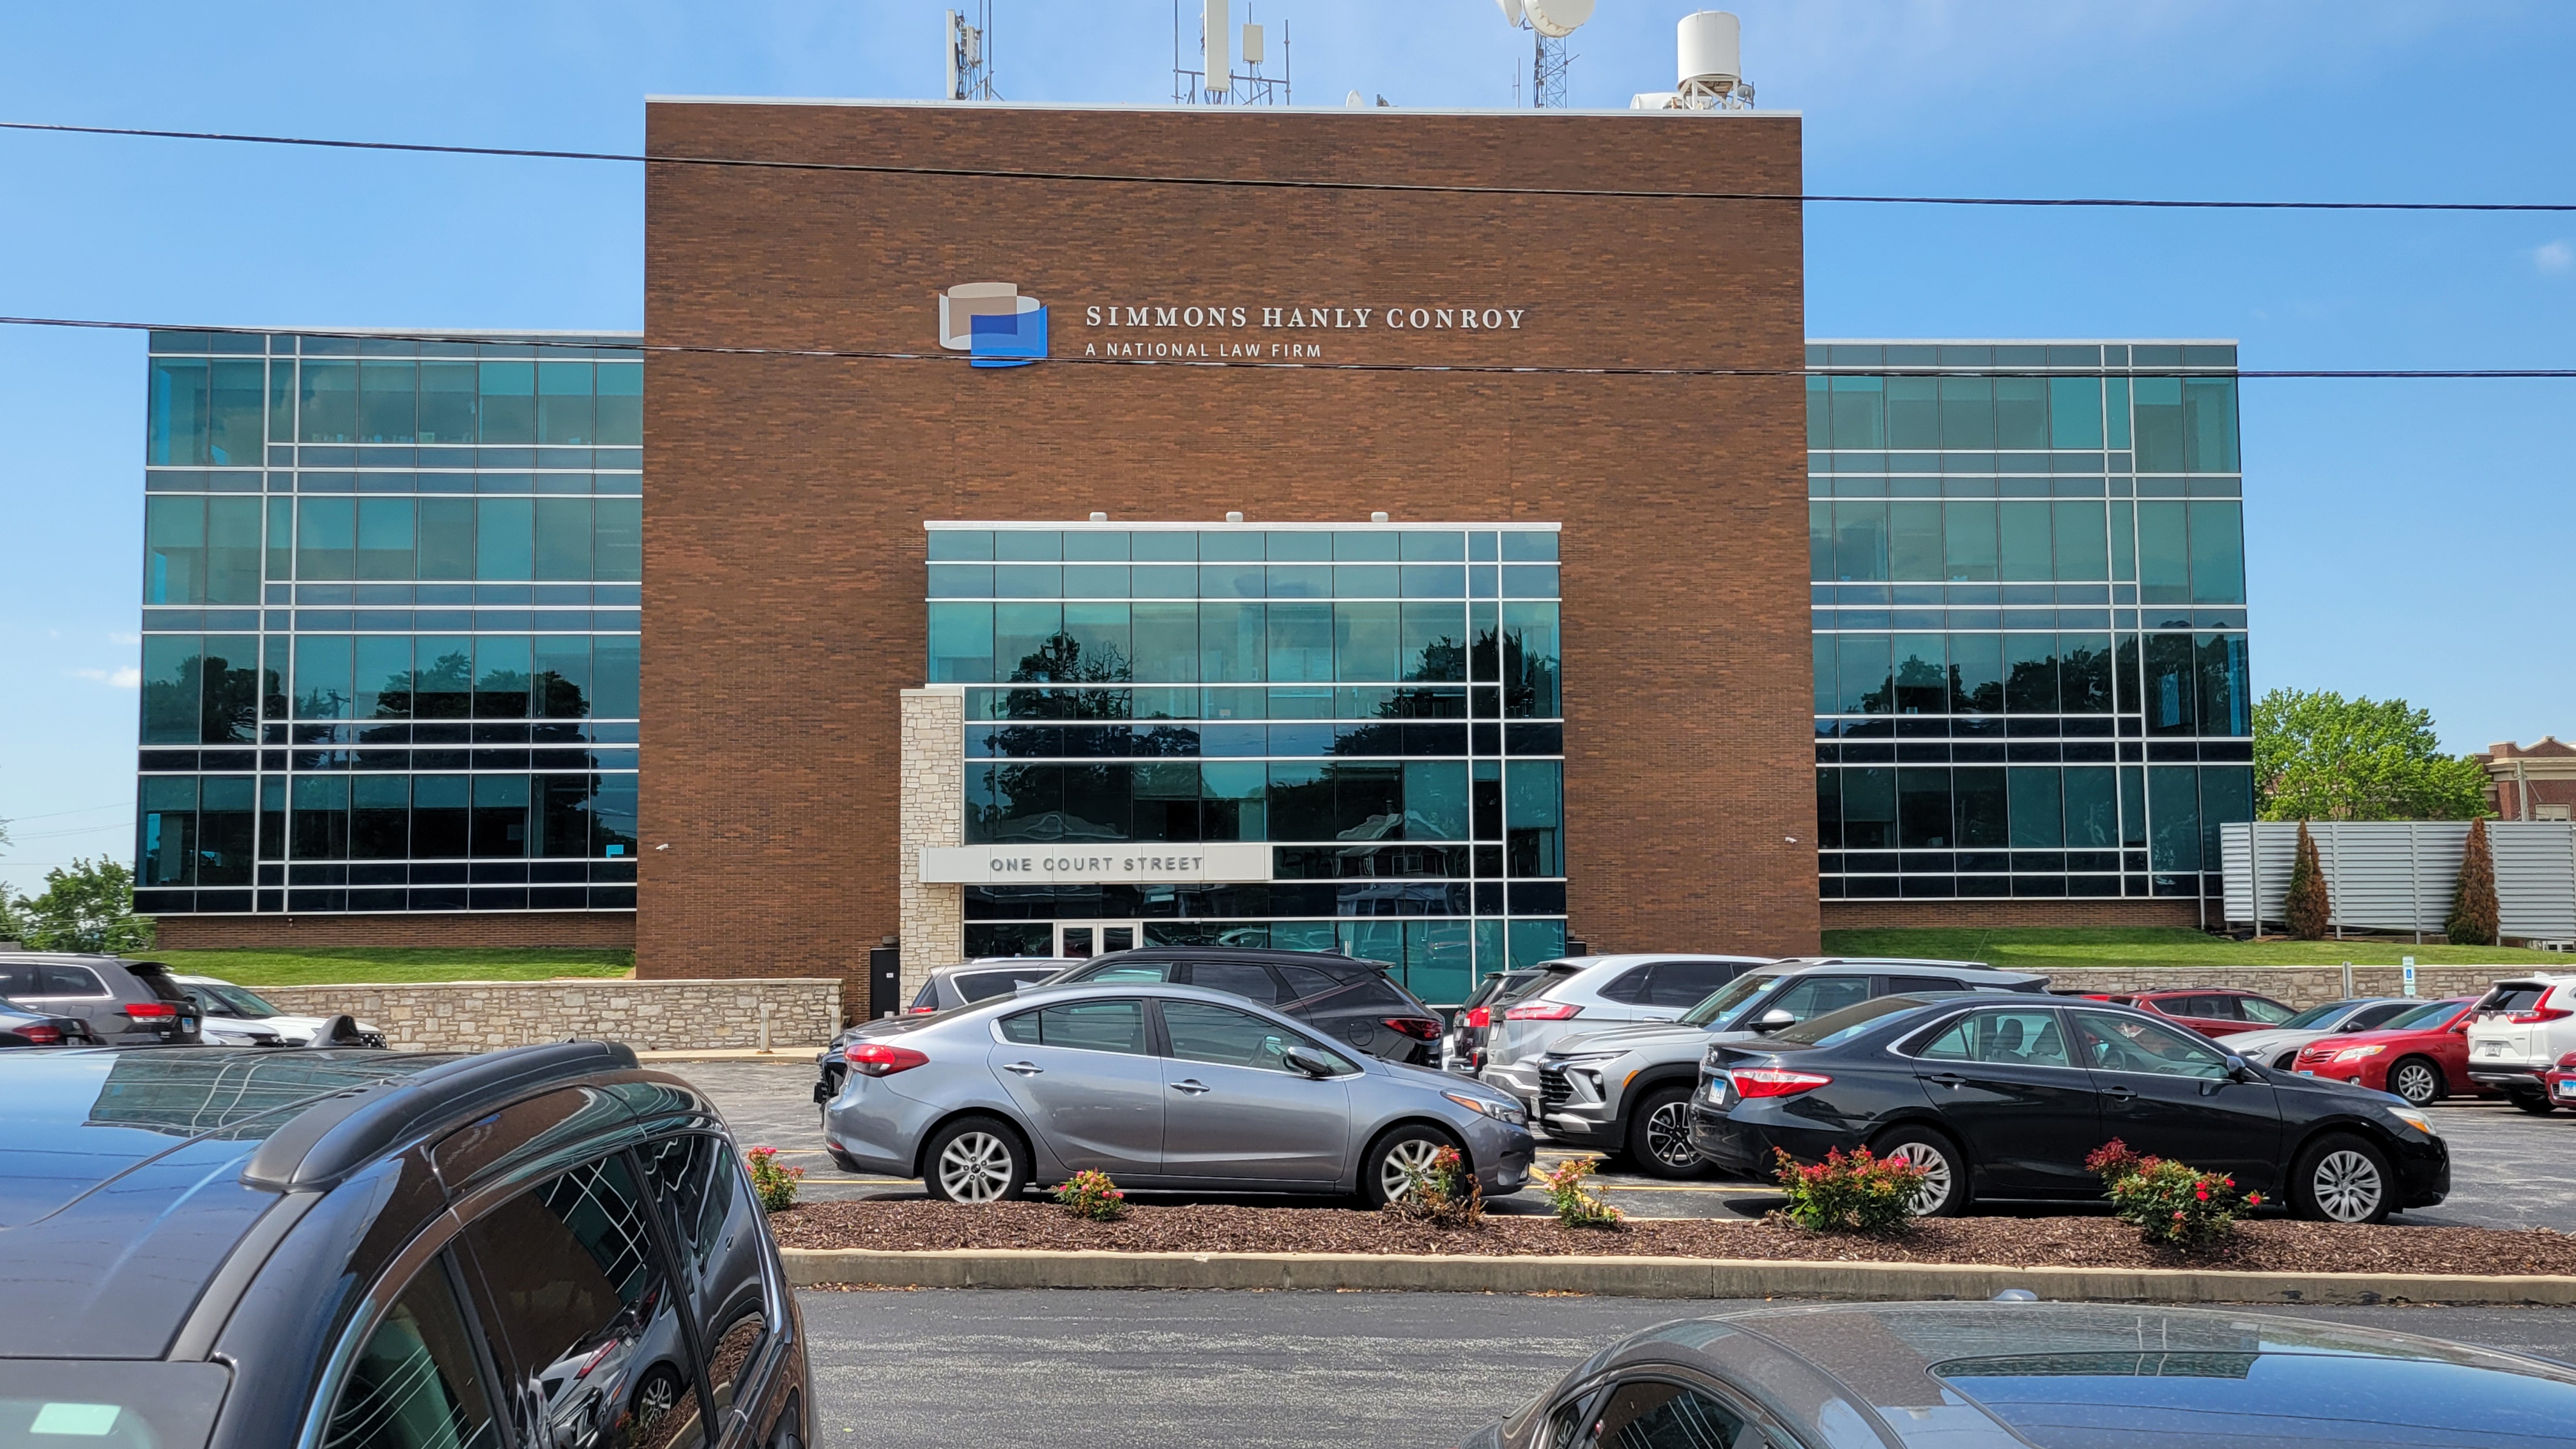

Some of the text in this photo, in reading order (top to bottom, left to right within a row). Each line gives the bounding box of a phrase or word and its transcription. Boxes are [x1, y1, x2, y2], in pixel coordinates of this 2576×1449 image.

[1086, 306, 1524, 329] SIMMONS HANLY CONROY
[1085, 342, 1321, 358] A NATIONAL LAW FIRM
[991, 857, 1202, 871] ONE COURT STREET
